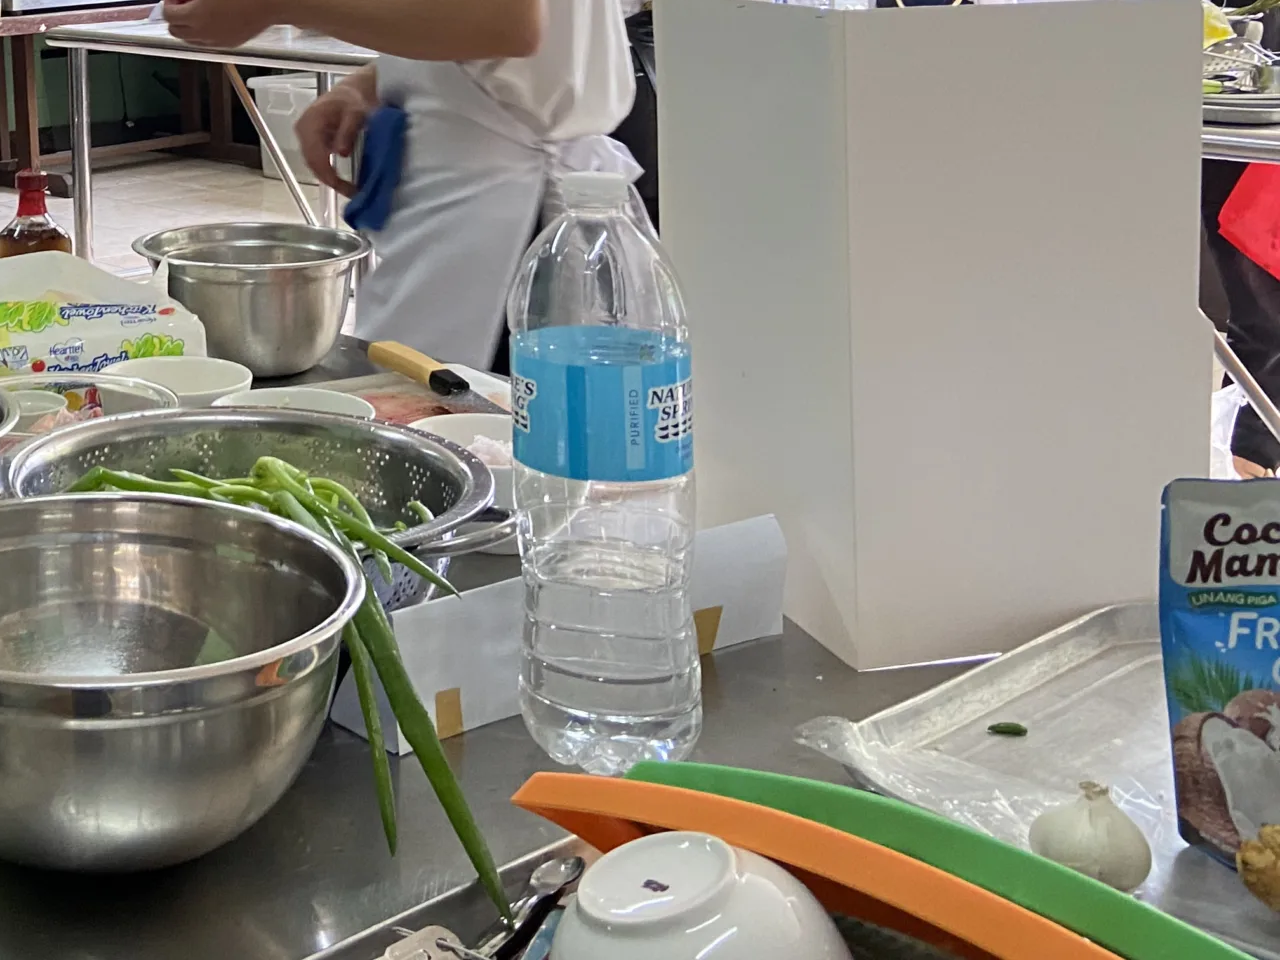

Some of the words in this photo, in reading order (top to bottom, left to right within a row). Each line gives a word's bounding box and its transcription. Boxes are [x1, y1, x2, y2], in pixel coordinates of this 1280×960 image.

[60, 303, 103, 320] Towel
[630, 389, 640, 446] PURIFIED
[1247, 595, 1277, 605] PIGA
[1228, 611, 1280, 650] FR
